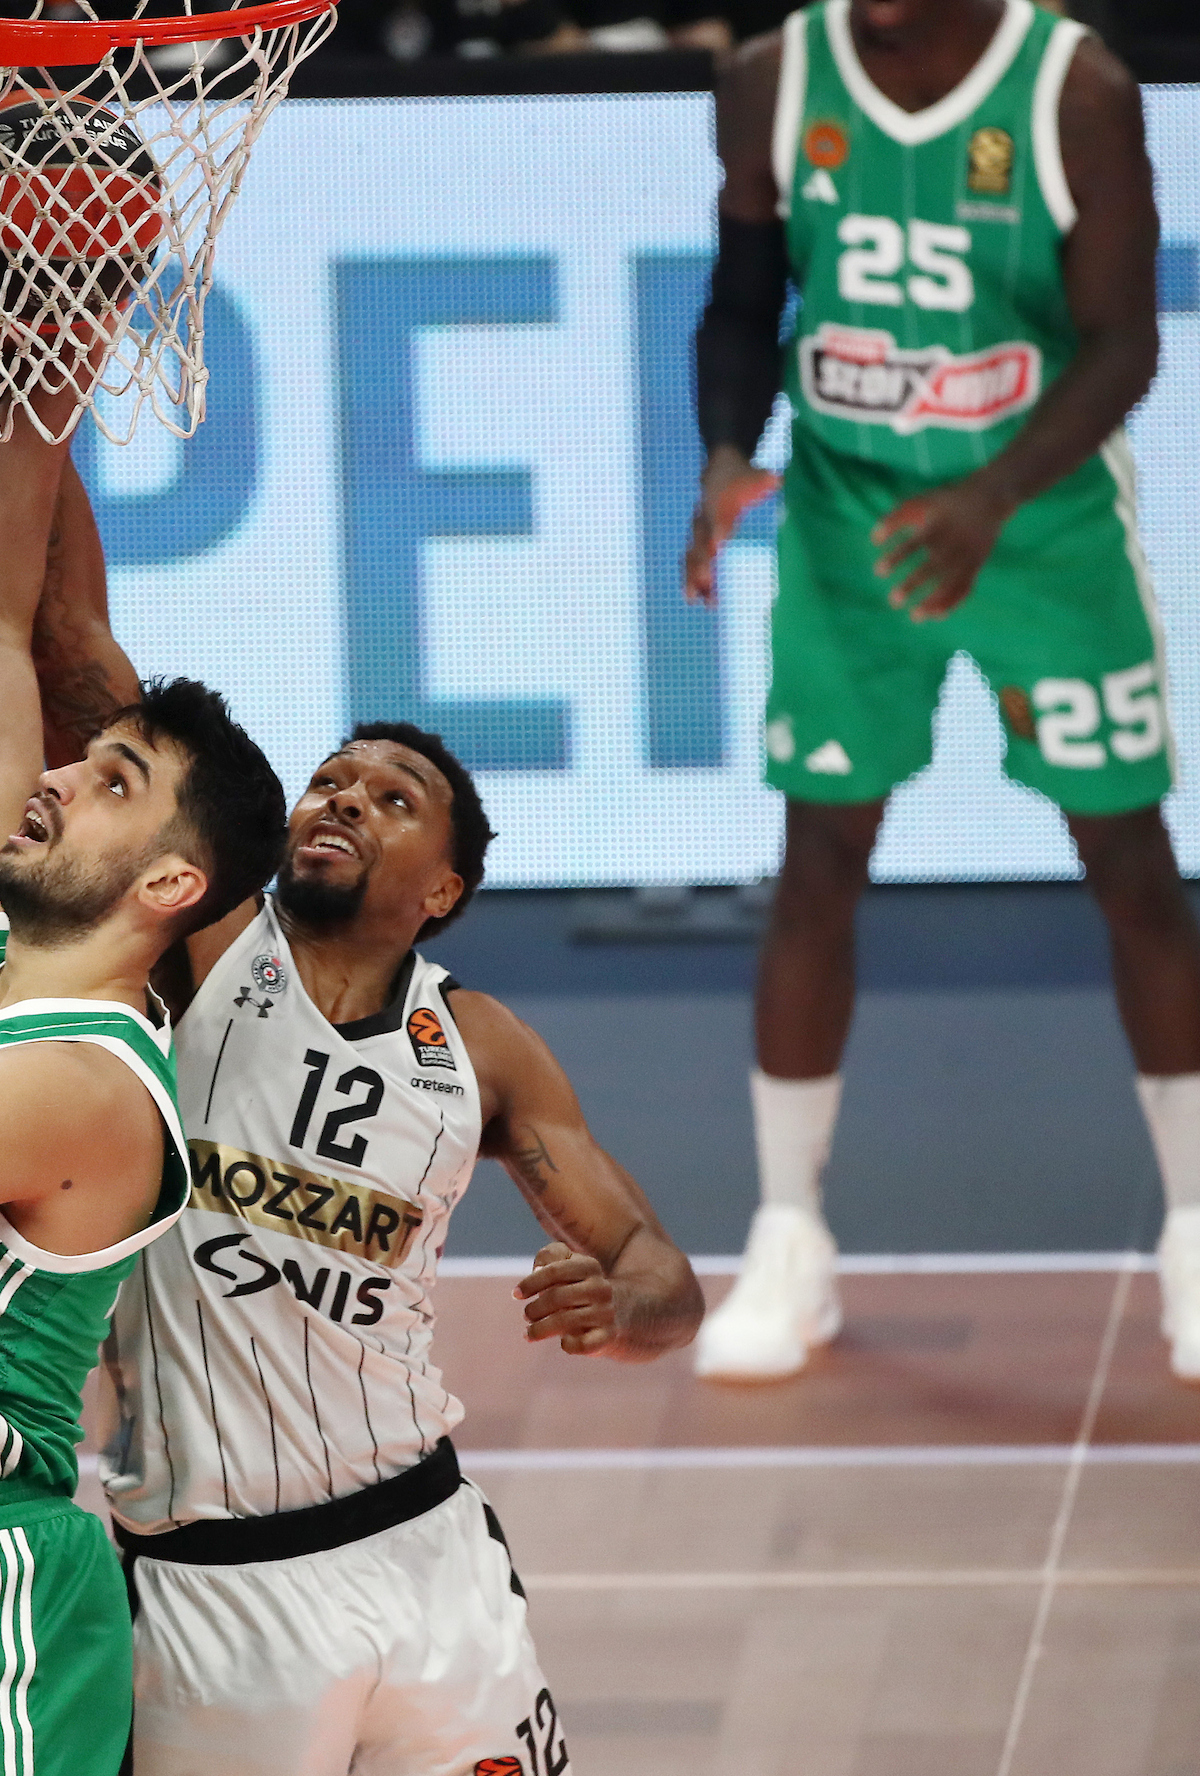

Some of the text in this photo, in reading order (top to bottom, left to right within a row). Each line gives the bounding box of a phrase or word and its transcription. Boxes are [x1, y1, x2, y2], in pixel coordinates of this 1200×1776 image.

[838, 213, 974, 313] 25
[1032, 663, 1162, 769] 25
[288, 1048, 386, 1168] 12
[410, 1077, 465, 1096] oneteam
[189, 1149, 423, 1253] MOZZART
[515, 1687, 570, 1776] 12
